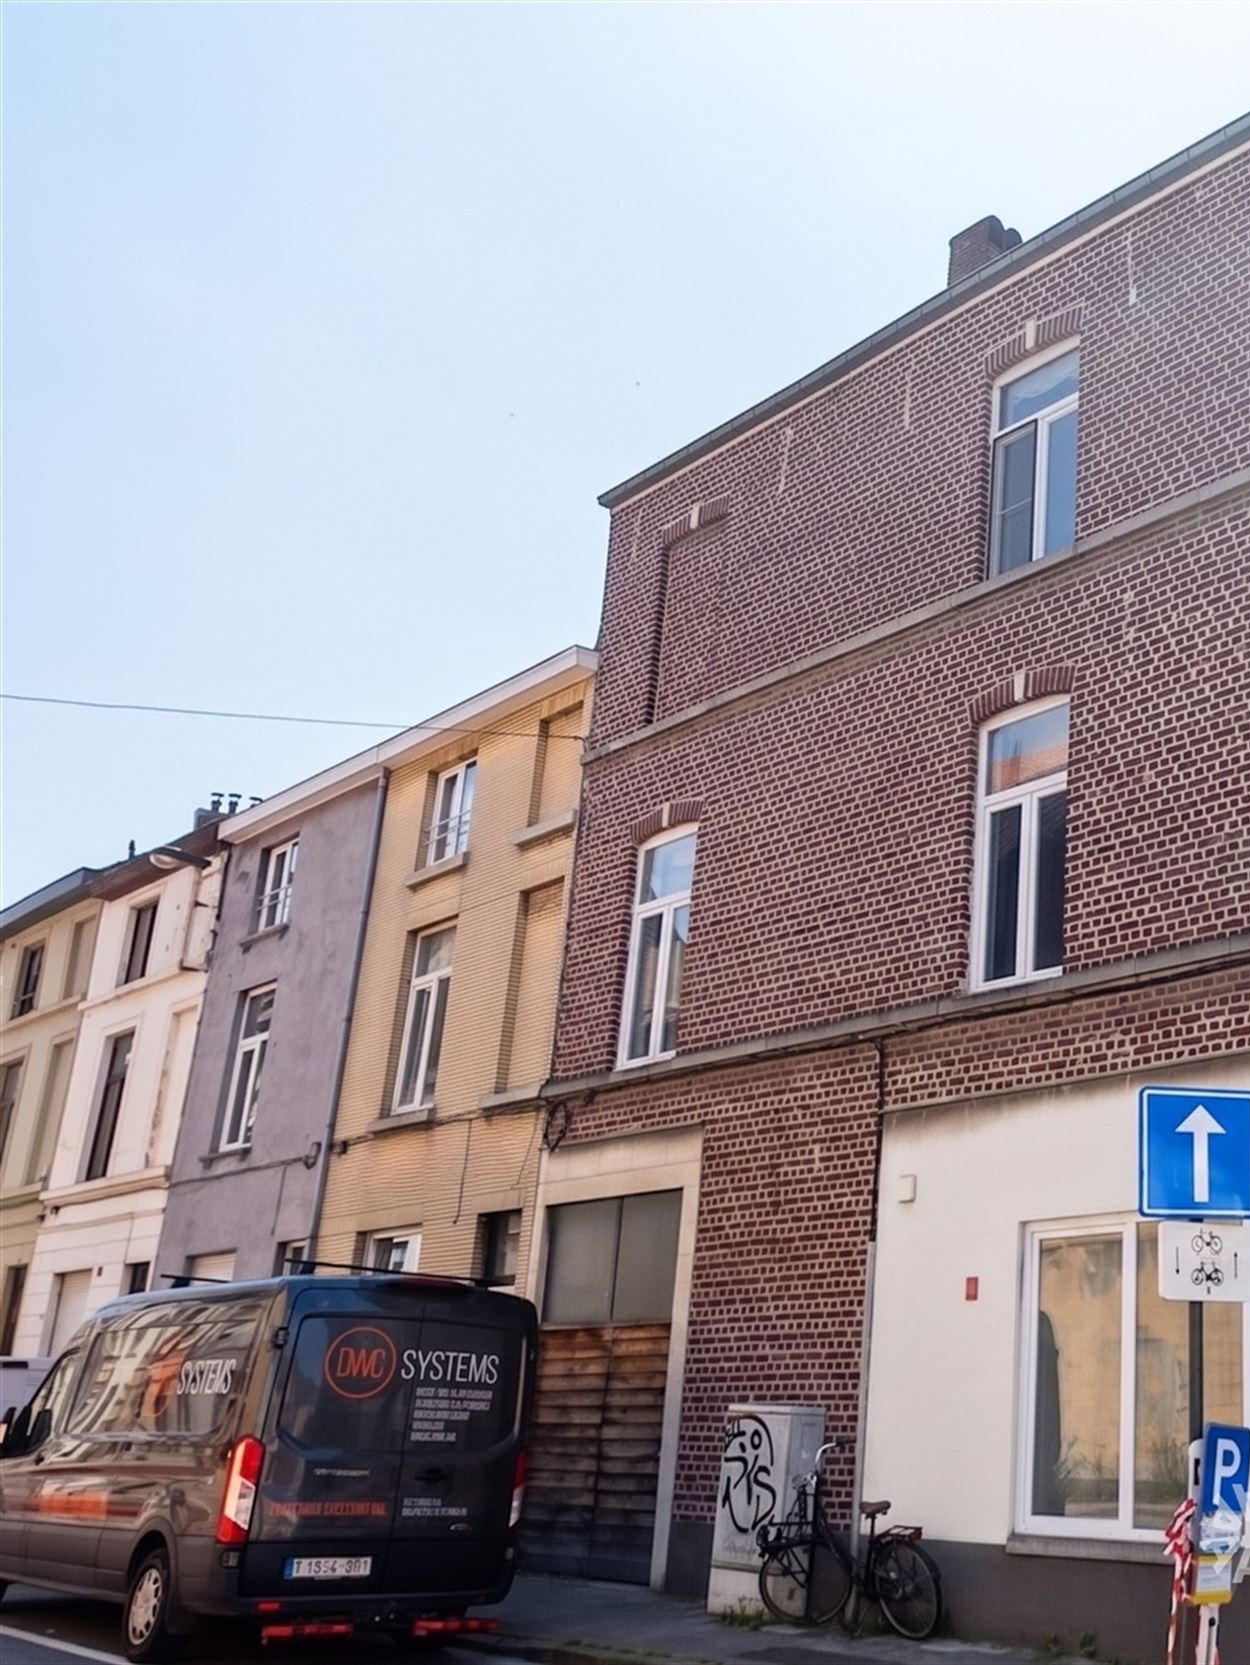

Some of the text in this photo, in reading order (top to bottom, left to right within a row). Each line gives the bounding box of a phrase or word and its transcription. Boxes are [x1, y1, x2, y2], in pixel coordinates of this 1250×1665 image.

[176, 1359, 237, 1395] SYSTEMS
[336, 1347, 500, 1384] DWC SYSTEMS
[1212, 1438, 1242, 1506] P
